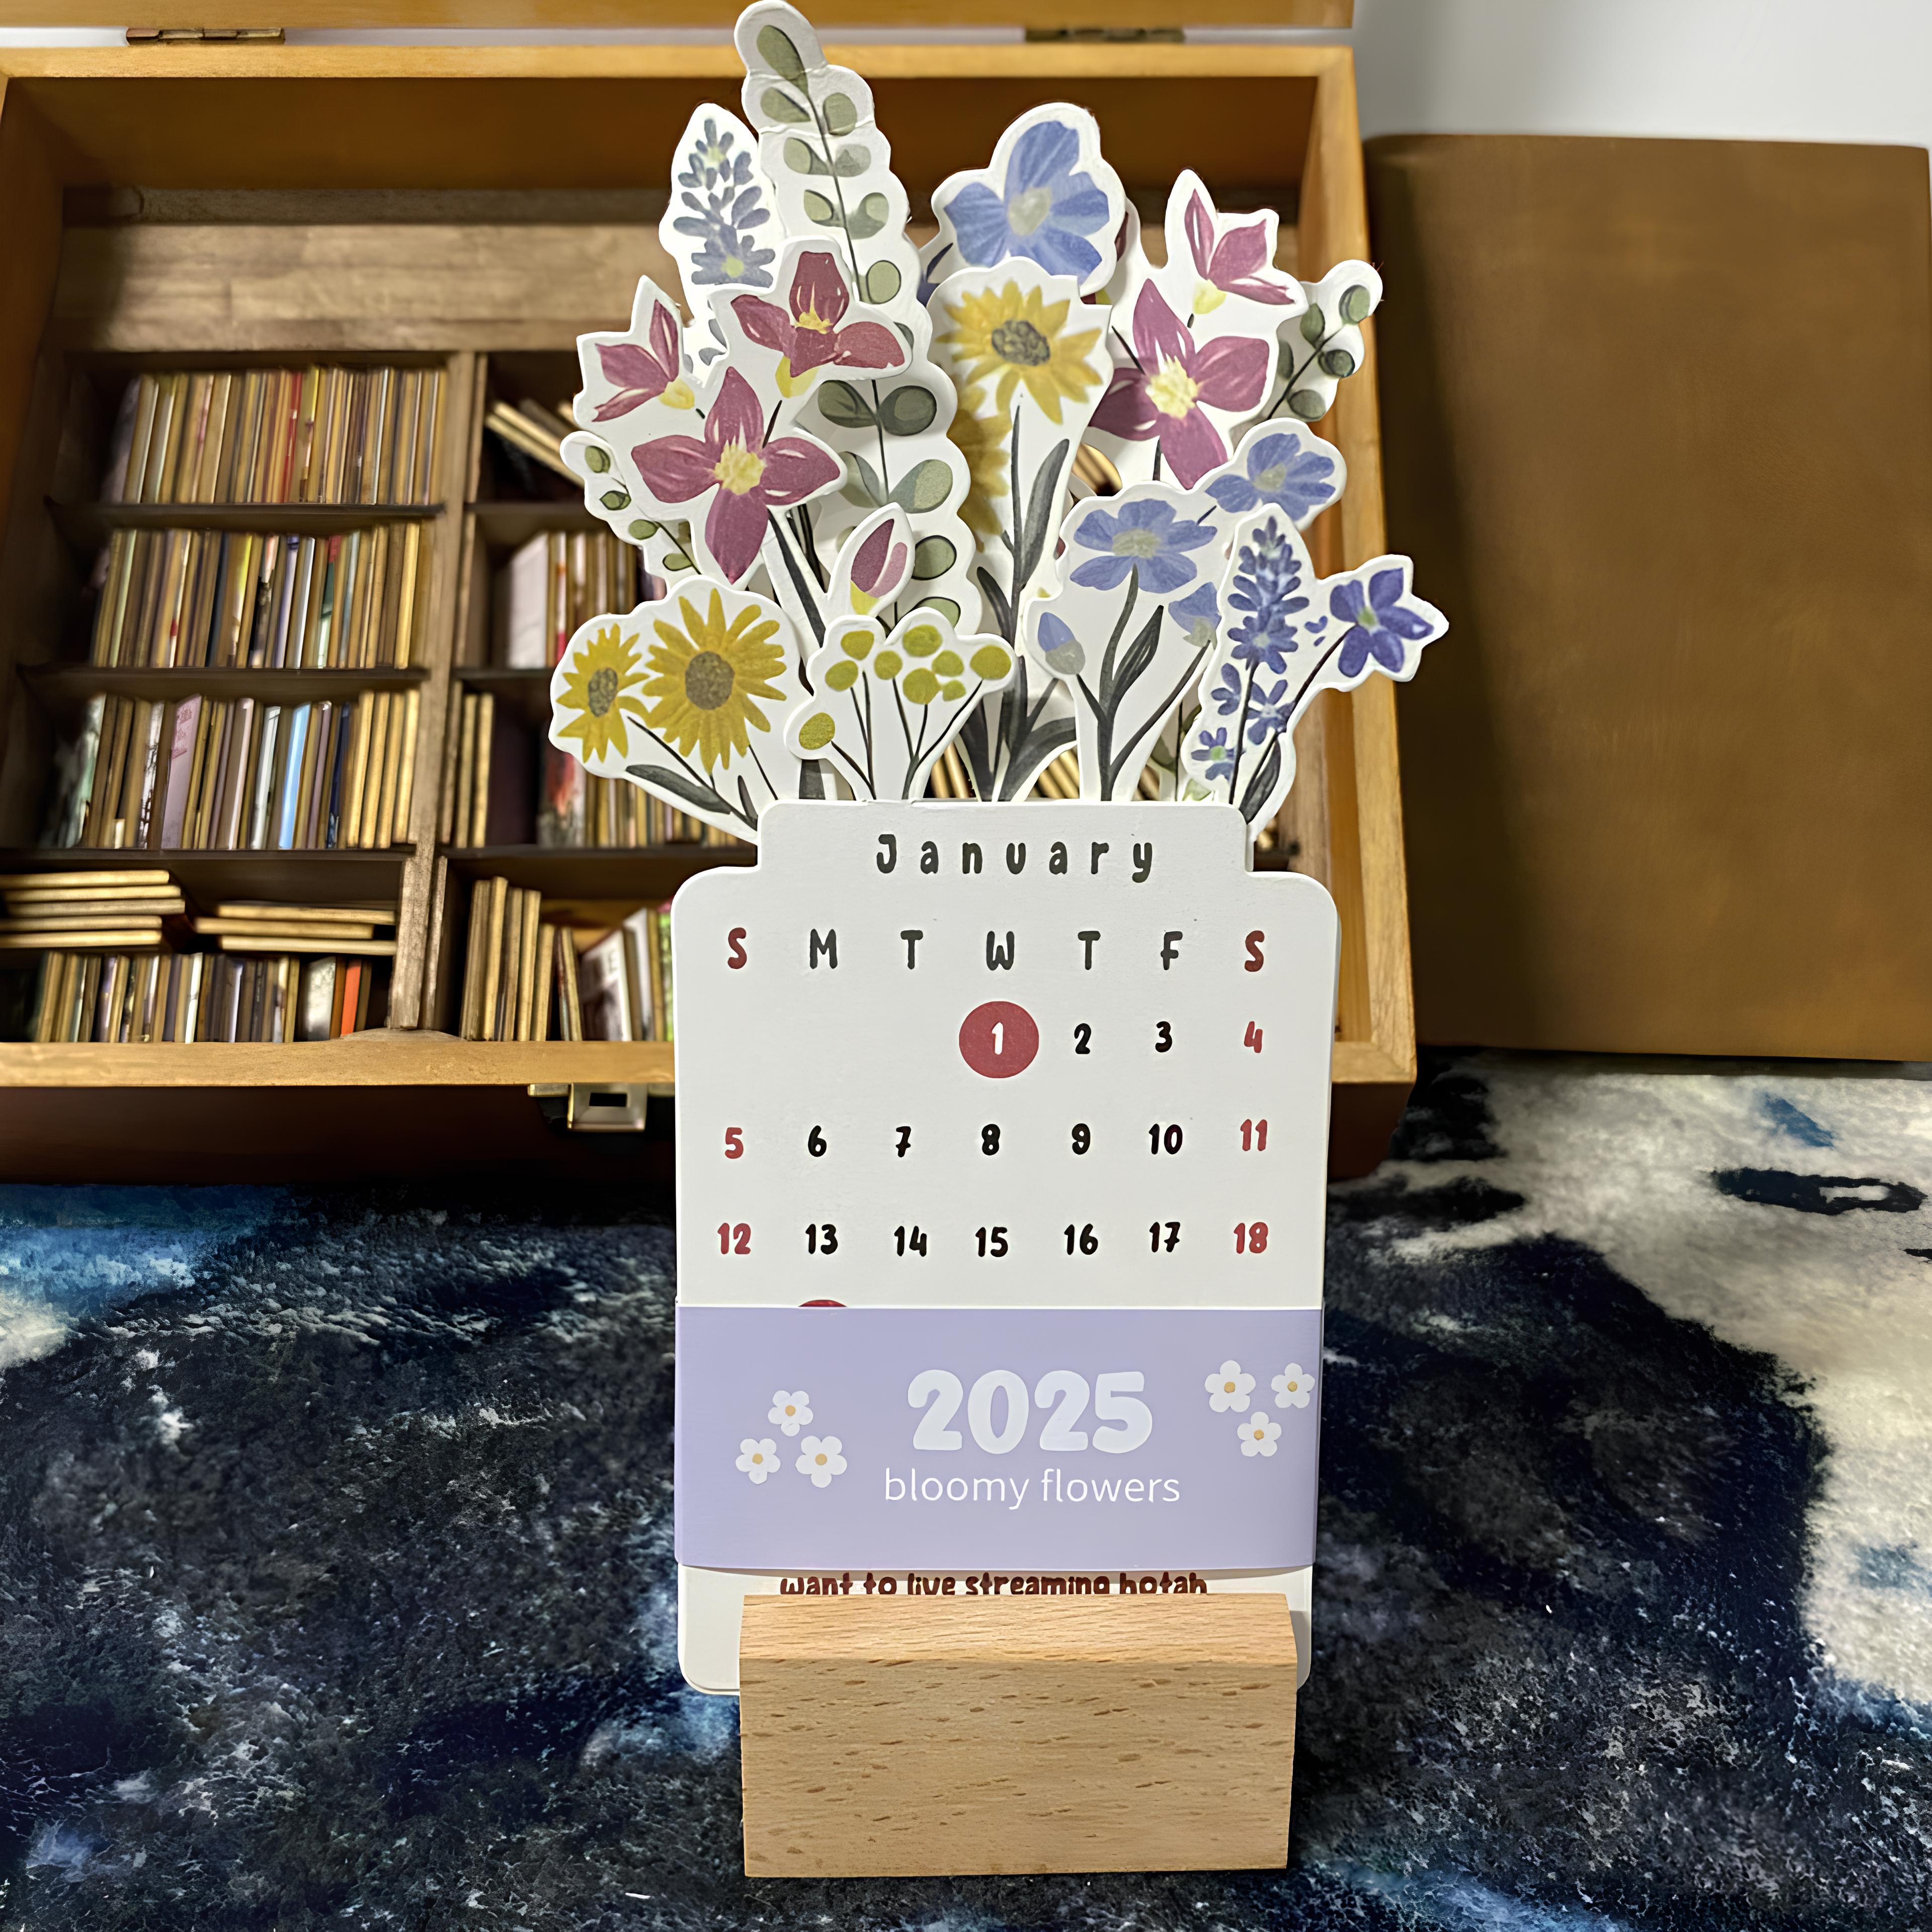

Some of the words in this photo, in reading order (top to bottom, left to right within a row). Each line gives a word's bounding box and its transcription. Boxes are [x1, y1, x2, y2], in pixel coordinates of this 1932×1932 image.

[876, 834, 1152, 883] January
[728, 928, 747, 969] S
[810, 929, 837, 969] M
[901, 930, 923, 970] T
[986, 931, 1014, 971] W
[1078, 931, 1100, 970] T
[1161, 931, 1183, 970] F
[1245, 930, 1264, 972] S
[992, 1022, 1004, 1055] 1
[1074, 1023, 1091, 1054] 2
[1155, 1021, 1172, 1053] 3
[1244, 1021, 1262, 1053] 4
[725, 1128, 743, 1159] 5
[808, 1125, 827, 1157] 6
[896, 1126, 911, 1158] 7
[982, 1124, 1000, 1156] 8
[1072, 1123, 1090, 1155] 9
[1149, 1123, 1182, 1155] 10
[1240, 1119, 1267, 1151] 11
[717, 1223, 751, 1254] 12
[806, 1224, 838, 1254] 13
[894, 1226, 927, 1257] 14
[976, 1227, 1008, 1257] 15
[1064, 1224, 1098, 1255] 16
[1150, 1222, 1180, 1252] 17
[1234, 1222, 1268, 1254] 18
[908, 1370, 1153, 1455] 2025
[885, 1468, 1030, 1510] bloomy
[1041, 1468, 1180, 1502] flowers
[780, 1572, 853, 1594] want
[863, 1572, 897, 1594] to
[908, 1573, 955, 1595] live
